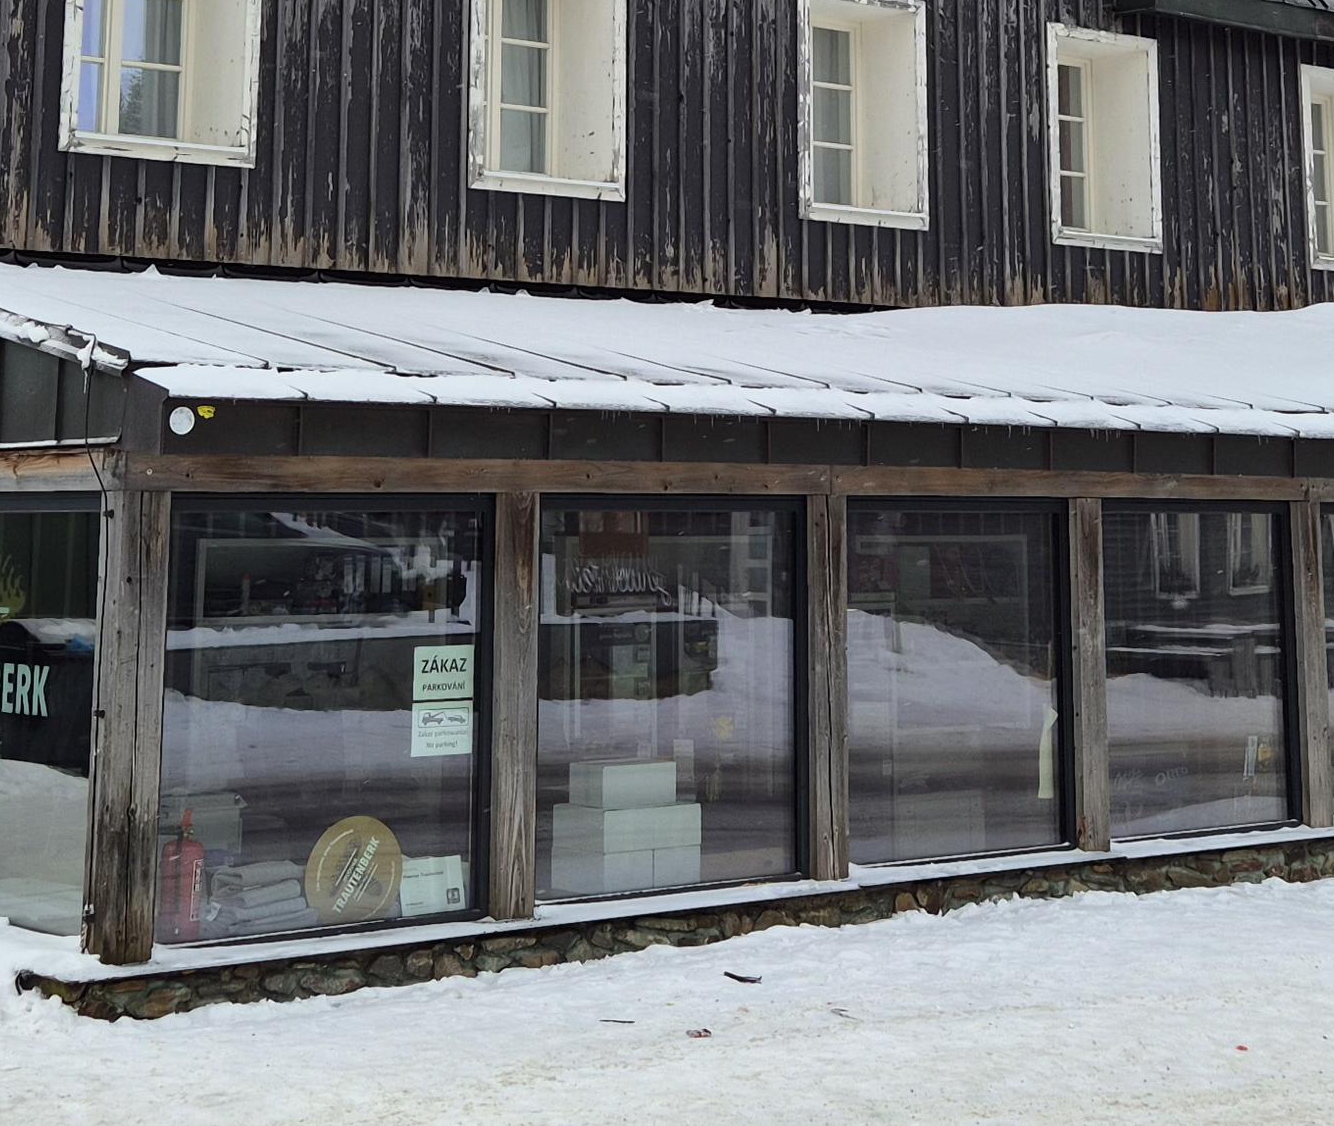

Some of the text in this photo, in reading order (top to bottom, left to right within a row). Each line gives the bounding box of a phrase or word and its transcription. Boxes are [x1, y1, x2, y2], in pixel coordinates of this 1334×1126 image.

[421, 655, 468, 674] ZÁKAZ
[422, 681, 466, 692] PARKOVÁNÍ
[331, 835, 380, 914] TRAUTENBERK
